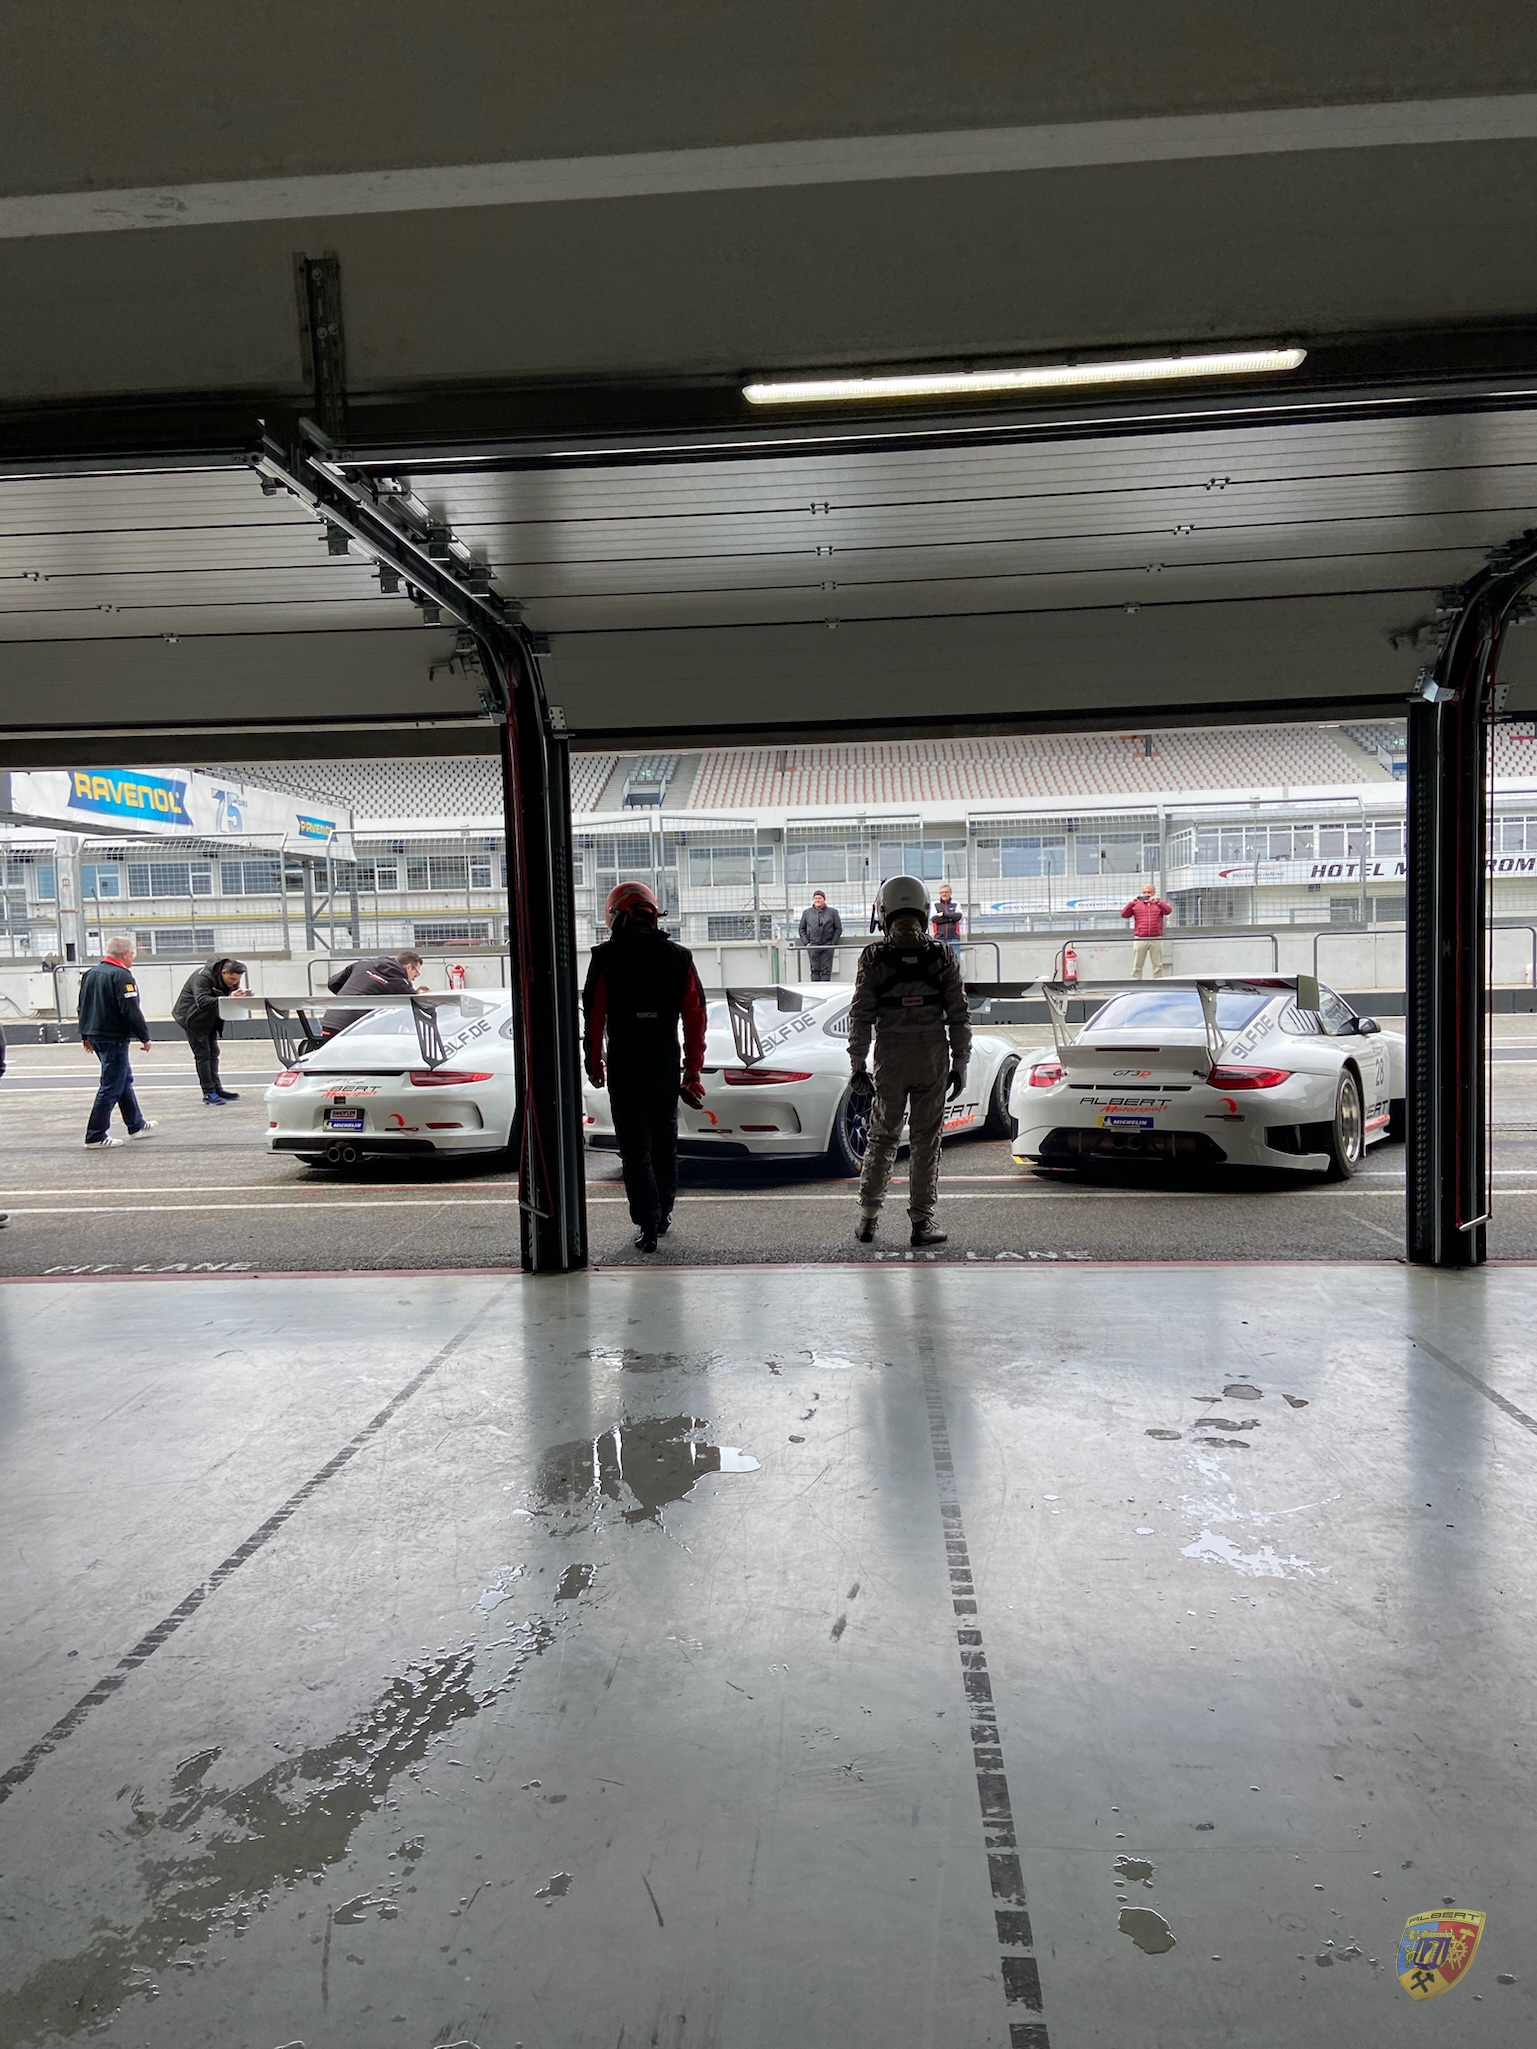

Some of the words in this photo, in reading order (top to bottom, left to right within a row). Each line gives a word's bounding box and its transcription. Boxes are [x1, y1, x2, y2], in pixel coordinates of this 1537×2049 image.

[74, 772, 182, 814] RAVENOL
[211, 787, 243, 833] 75
[1311, 863, 1385, 878] HOTEL
[1079, 1097, 1173, 1107] ALBERT
[1099, 1105, 1169, 1113] Motorsport
[966, 1251, 1093, 1260] LANE
[132, 1261, 260, 1272] LANE
